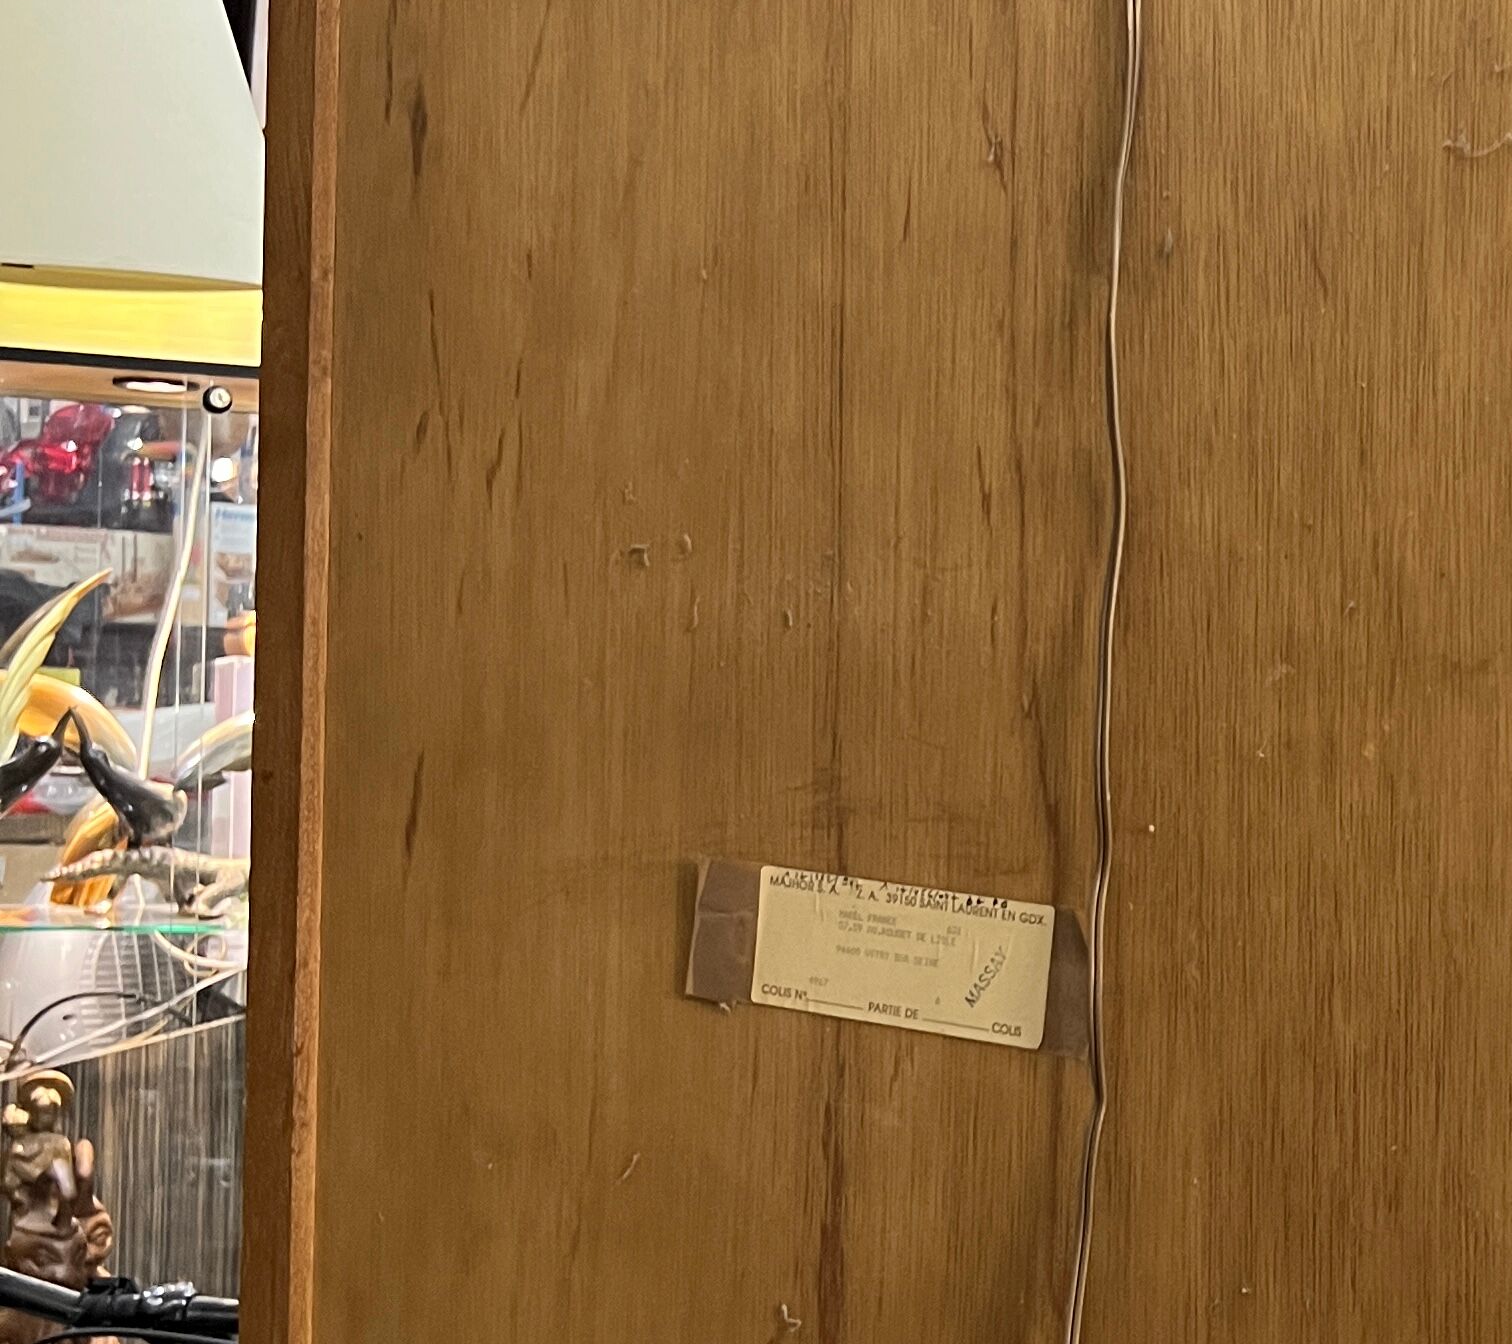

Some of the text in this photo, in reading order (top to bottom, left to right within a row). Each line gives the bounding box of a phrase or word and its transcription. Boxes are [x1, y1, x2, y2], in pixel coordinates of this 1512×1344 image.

[919, 895, 948, 912] SAINT
[951, 897, 999, 919] LAURENT
[761, 983, 792, 999] COLIS
[867, 1001, 902, 1018] PARTIE
[904, 1007, 919, 1020] DE
[991, 1022, 1022, 1038] COLIS
